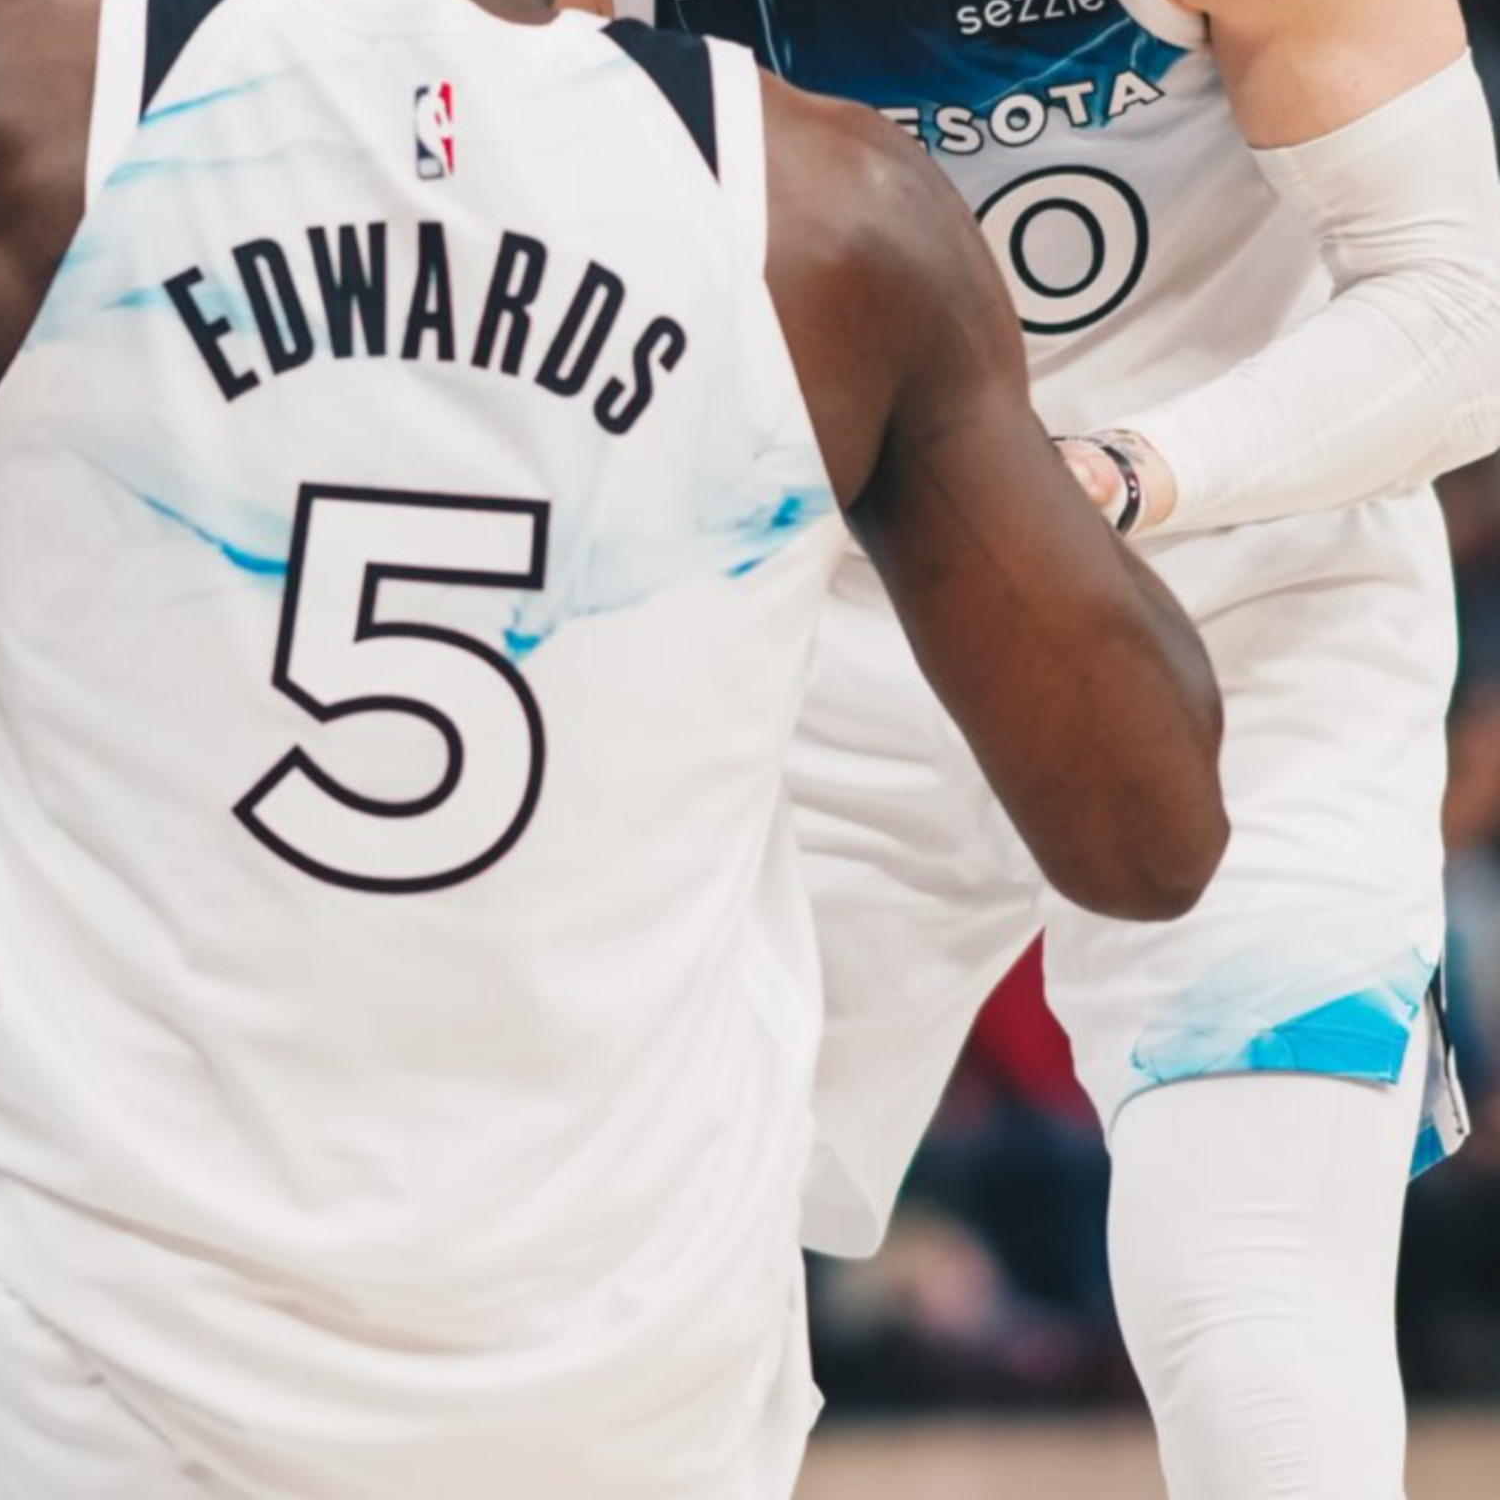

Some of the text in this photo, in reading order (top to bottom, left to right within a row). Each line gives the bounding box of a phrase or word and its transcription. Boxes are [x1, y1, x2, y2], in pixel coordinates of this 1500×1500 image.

[164, 222, 687, 435] EDWARDS
[974, 165, 1149, 334] 0
[233, 483, 551, 894] 5
